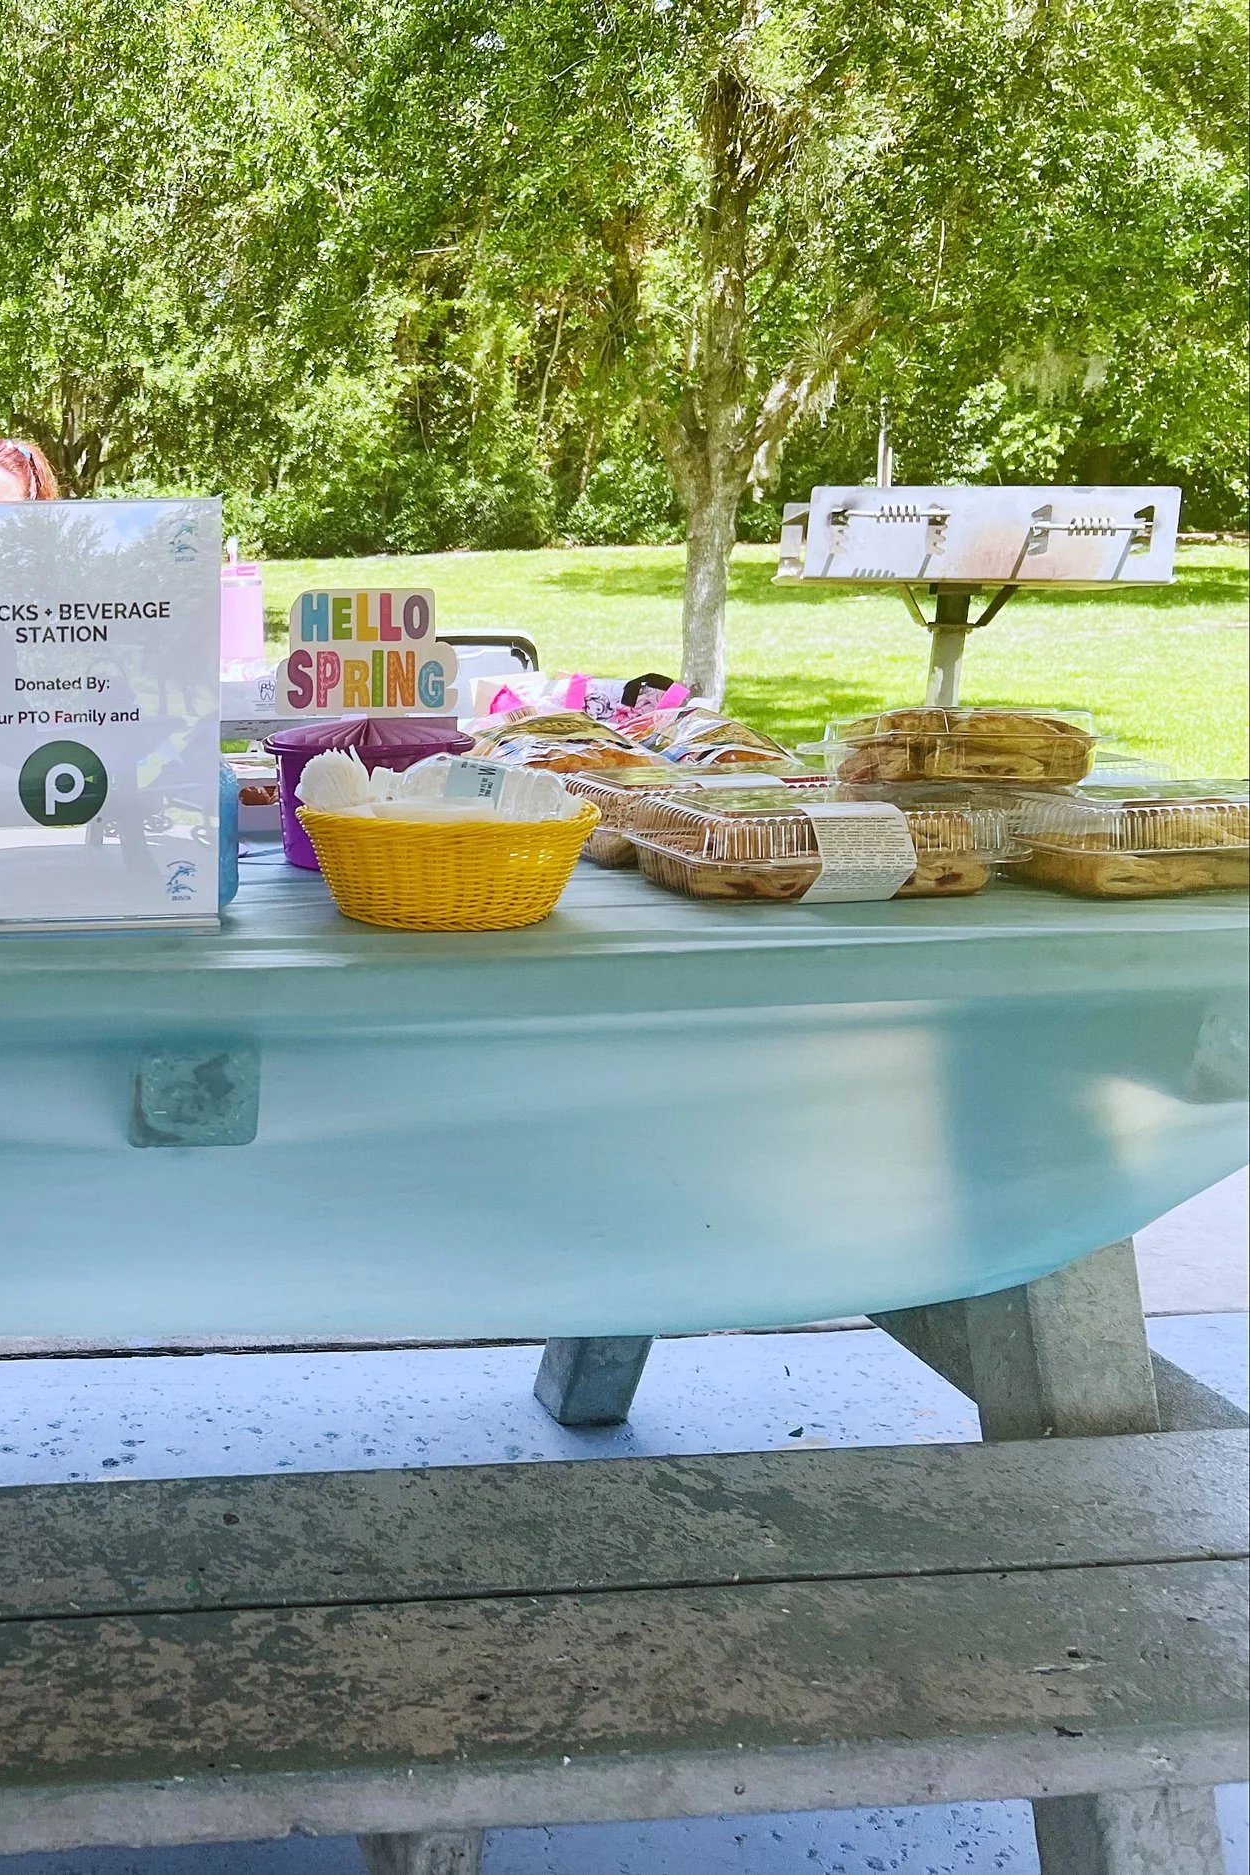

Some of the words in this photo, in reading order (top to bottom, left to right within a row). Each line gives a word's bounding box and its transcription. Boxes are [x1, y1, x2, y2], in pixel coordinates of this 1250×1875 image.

[59, 601, 171, 621] BEVERAGE
[301, 592, 430, 642] HELLO
[15, 625, 108, 644] STATION
[14, 677, 82, 692] Donated
[86, 676, 111, 694] By:
[287, 649, 445, 709] SPRING
[18, 710, 51, 725] PTO
[54, 709, 107, 728] Family
[110, 708, 140, 723] and
